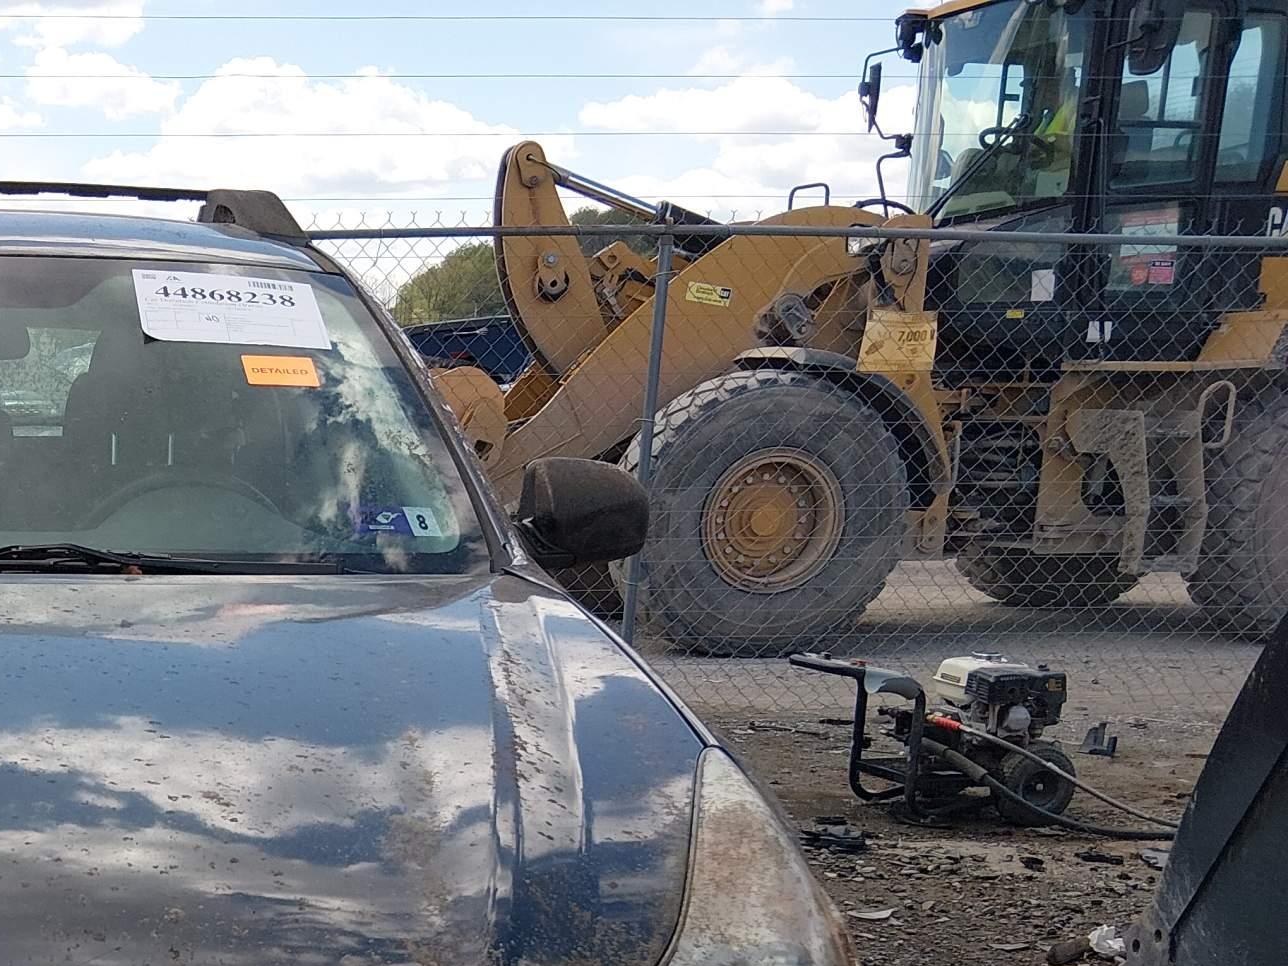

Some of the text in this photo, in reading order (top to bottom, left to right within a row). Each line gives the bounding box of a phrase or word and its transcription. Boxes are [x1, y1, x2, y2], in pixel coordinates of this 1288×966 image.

[155, 285, 296, 307] 44868238
[897, 330, 927, 343] 7,000
[251, 367, 309, 375] DETAILED
[416, 514, 429, 530] 8
